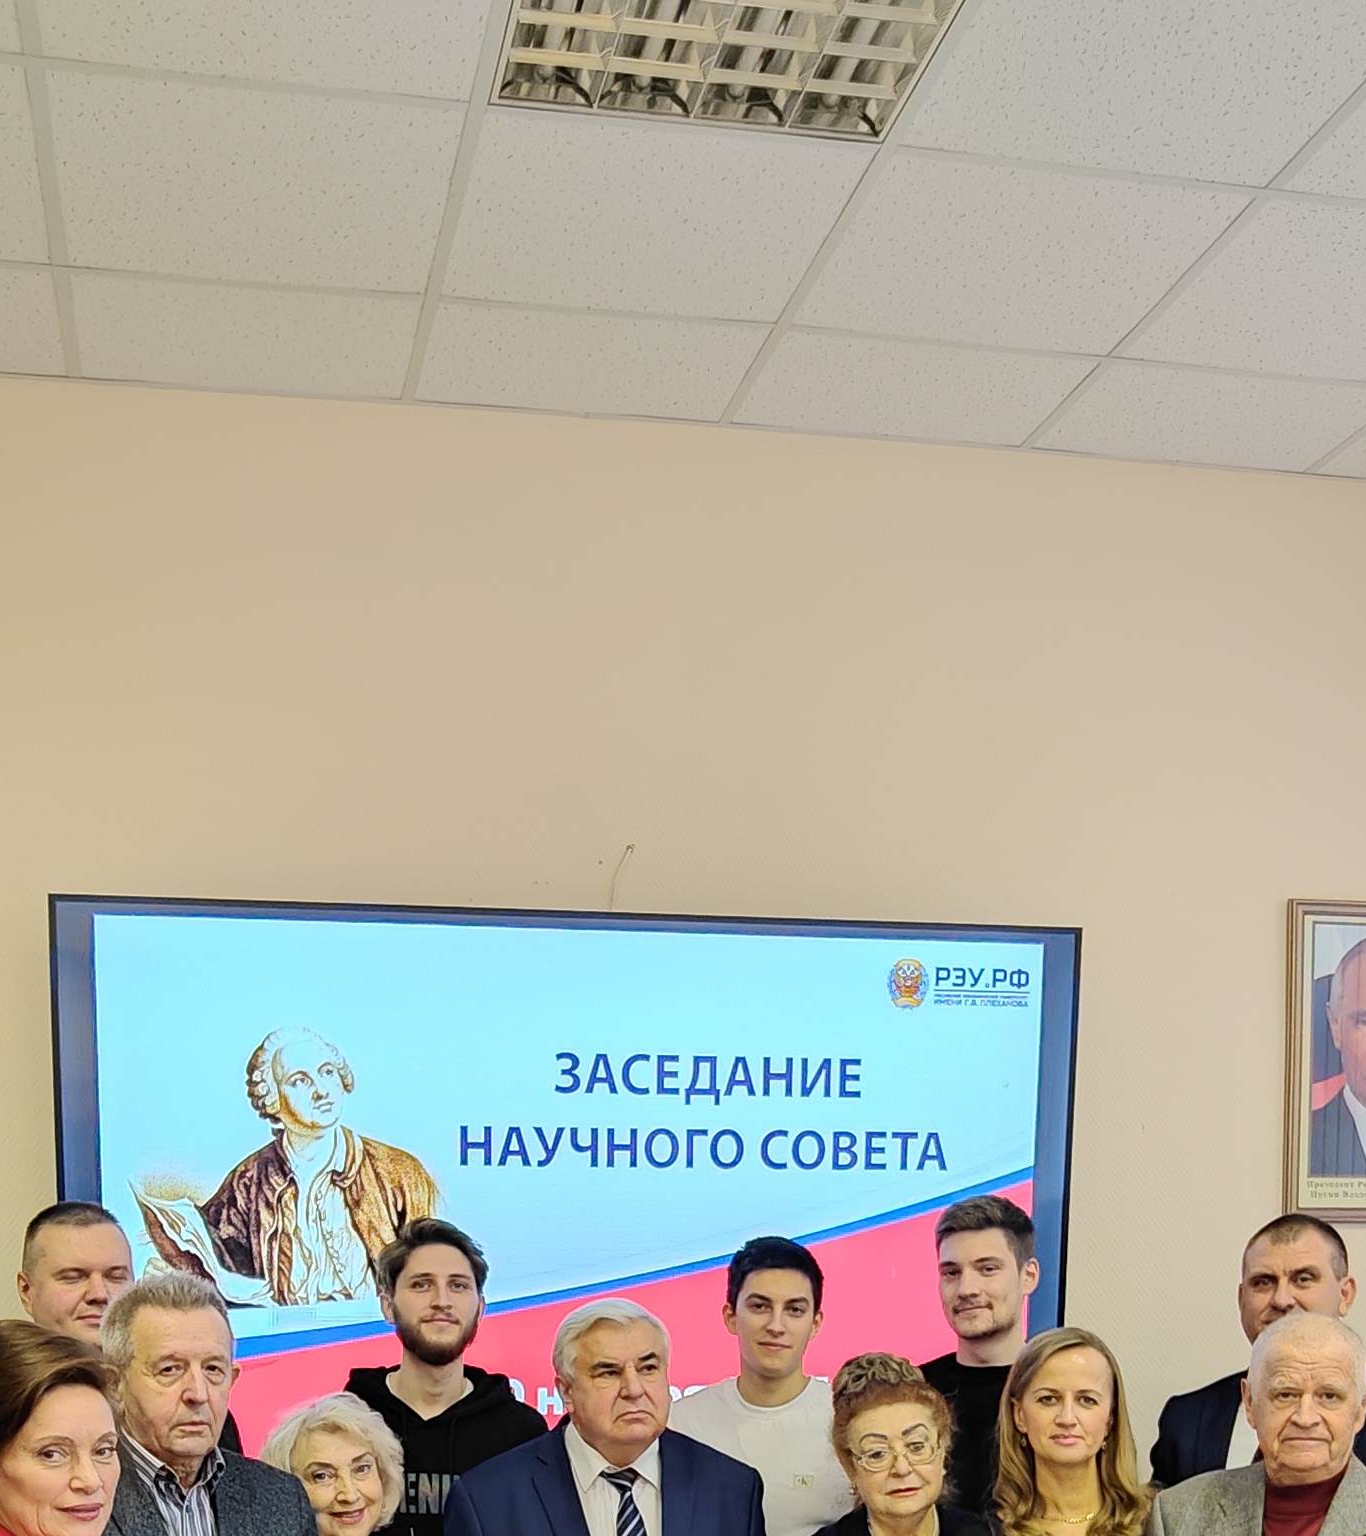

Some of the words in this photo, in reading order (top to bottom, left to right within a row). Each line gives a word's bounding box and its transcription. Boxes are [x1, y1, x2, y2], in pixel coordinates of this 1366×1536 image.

[935, 966, 1030, 989] РЭУ.РФ
[553, 1052, 863, 1106] ЗАСЕДАНИЕ
[459, 1125, 745, 1169] НАУЧНОГО
[759, 1129, 949, 1171] СОВЕТА
